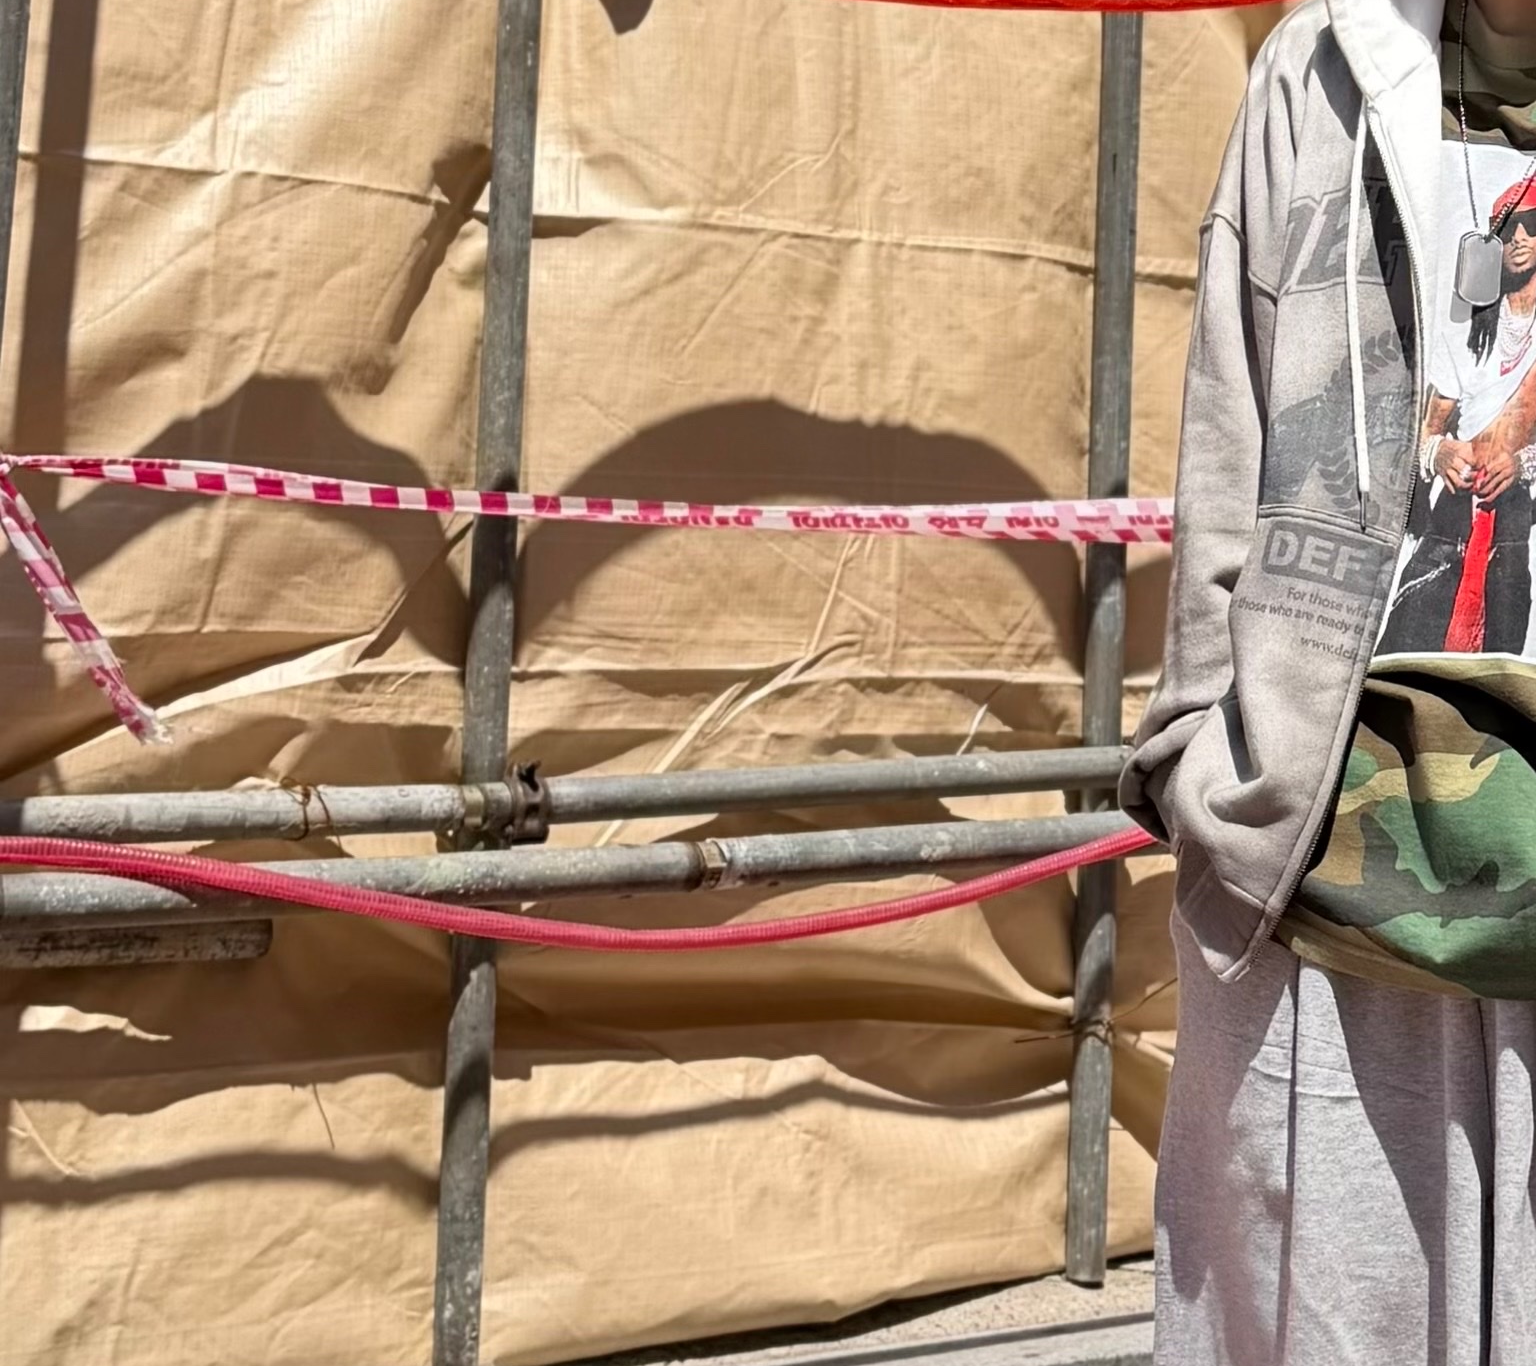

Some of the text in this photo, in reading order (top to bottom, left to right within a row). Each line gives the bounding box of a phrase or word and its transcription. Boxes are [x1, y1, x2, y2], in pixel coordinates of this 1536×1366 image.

[1287, 587, 1306, 601] For
[1309, 593, 1343, 612] those
[1269, 604, 1292, 617] who
[1294, 609, 1314, 621] are
[1316, 615, 1352, 635] ready
